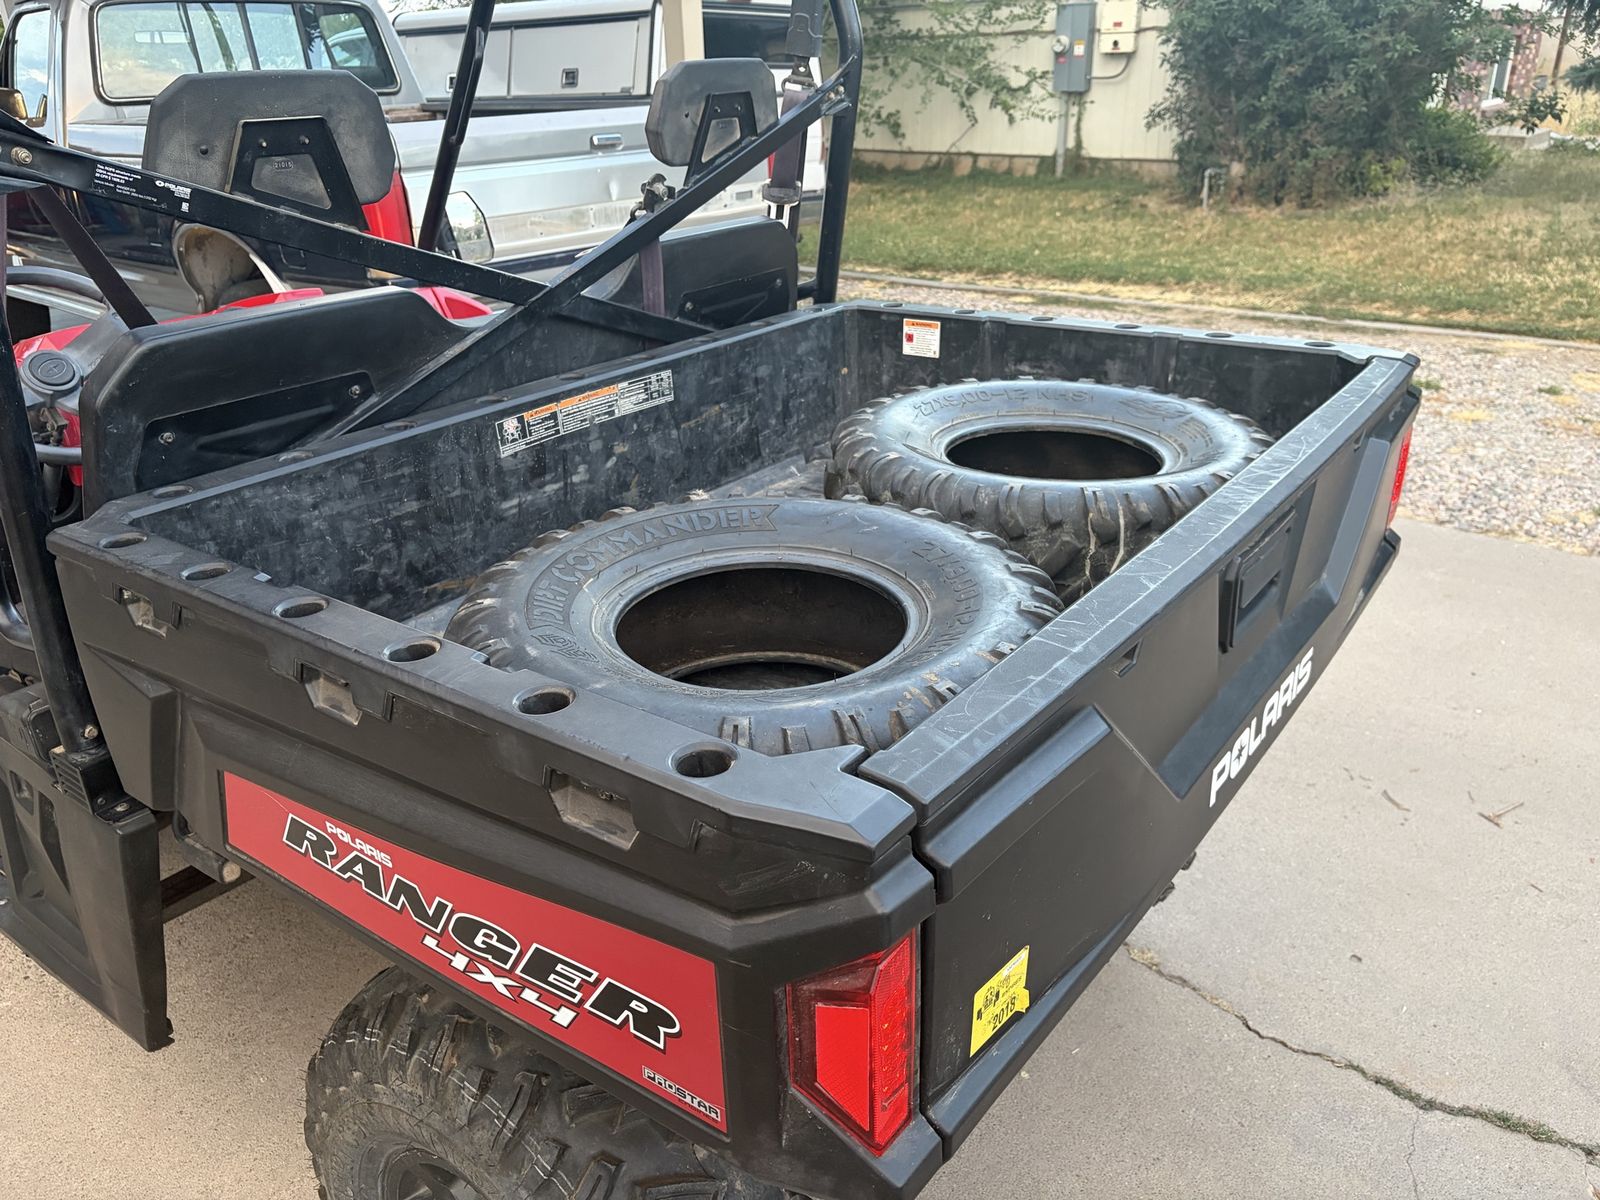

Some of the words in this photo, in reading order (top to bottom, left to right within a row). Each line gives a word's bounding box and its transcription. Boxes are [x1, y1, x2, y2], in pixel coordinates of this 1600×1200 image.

[550, 507, 765, 582] COMMANDER
[532, 578, 570, 625] DIRT
[1209, 646, 1314, 808] POLARIS
[325, 820, 392, 869] POLARIS
[282, 812, 683, 1053] RANGER
[992, 996, 1017, 1032] 2018
[643, 1066, 720, 1119] PROSTAR
